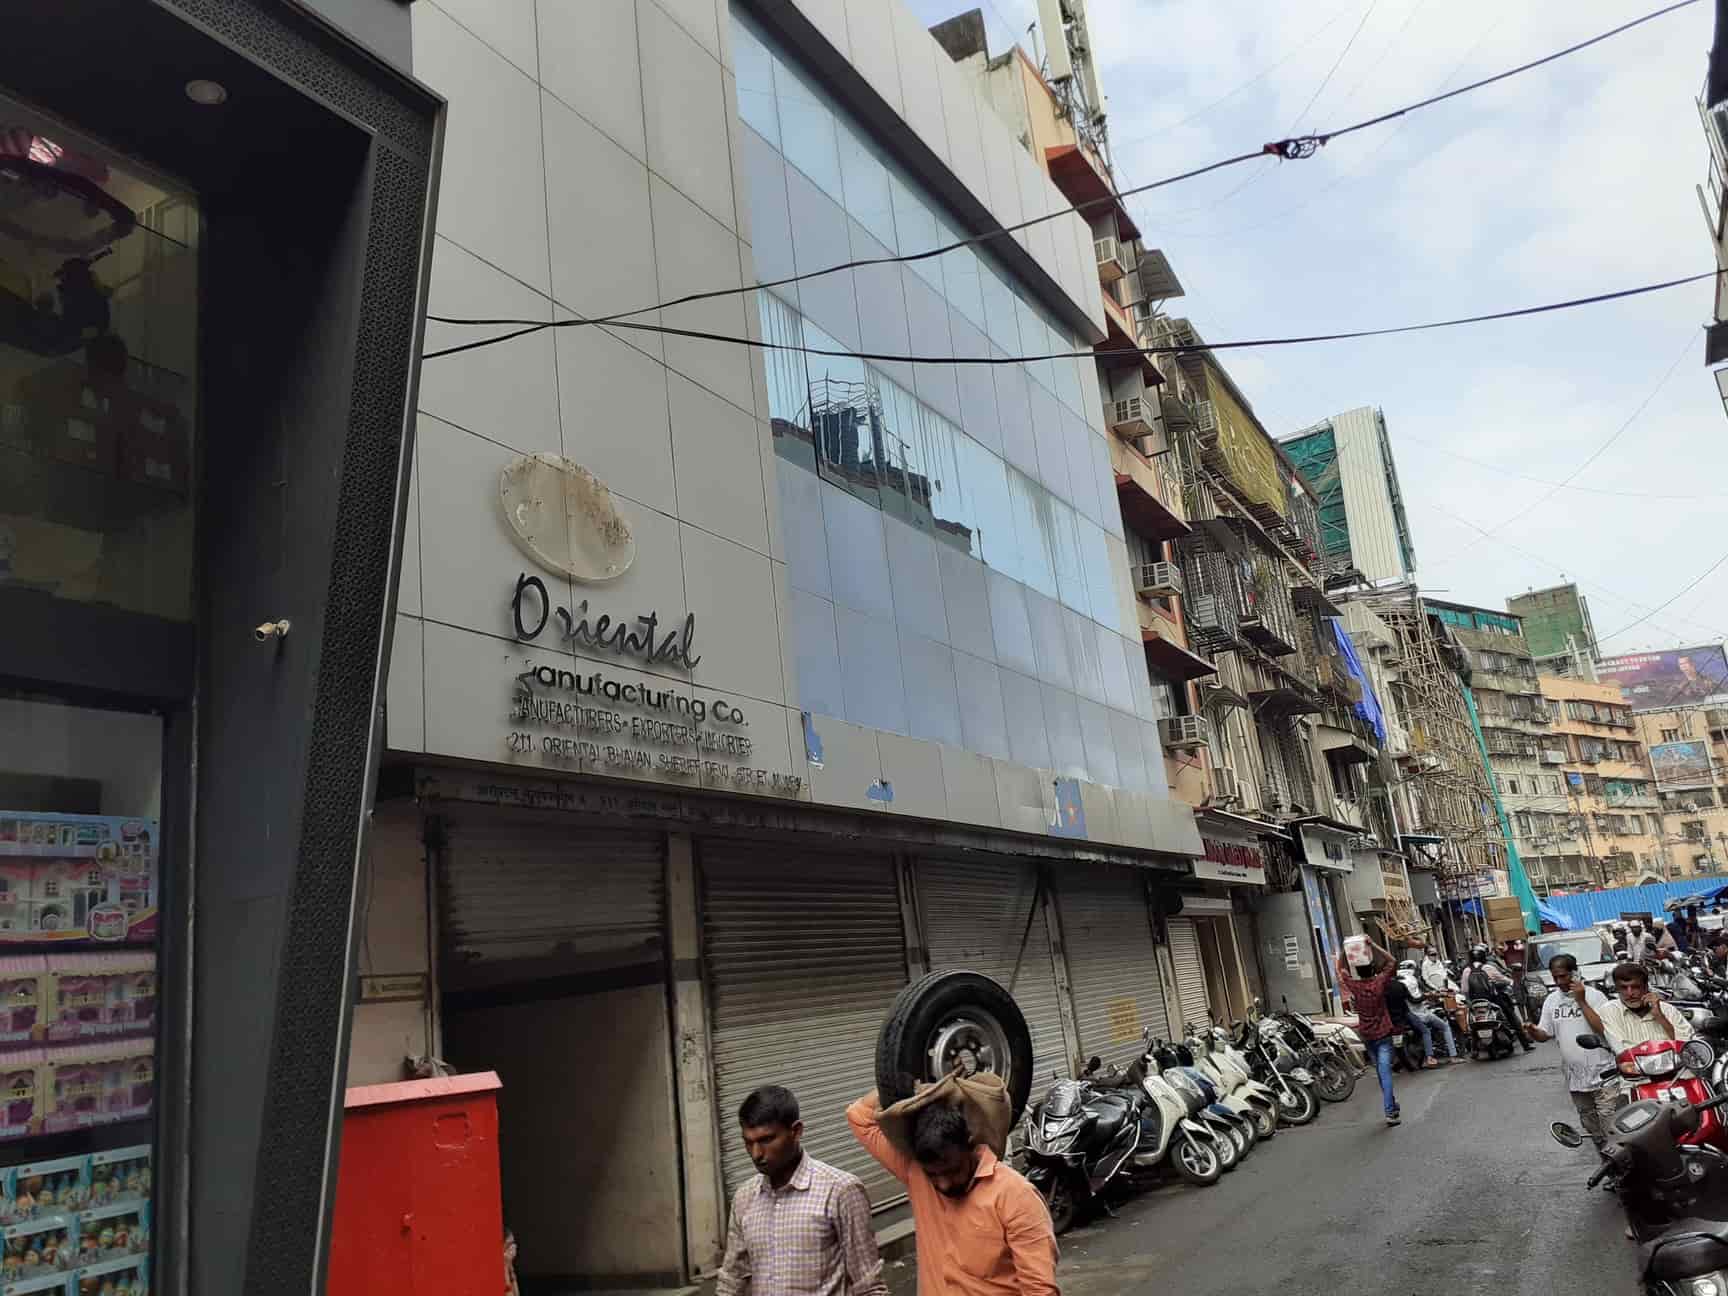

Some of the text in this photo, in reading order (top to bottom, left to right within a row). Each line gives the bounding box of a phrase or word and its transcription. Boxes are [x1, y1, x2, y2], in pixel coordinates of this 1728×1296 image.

[512, 572, 701, 669] Oriental
[517, 664, 750, 727] anufacturing Co.
[1554, 1008, 1583, 1019] BLAC
